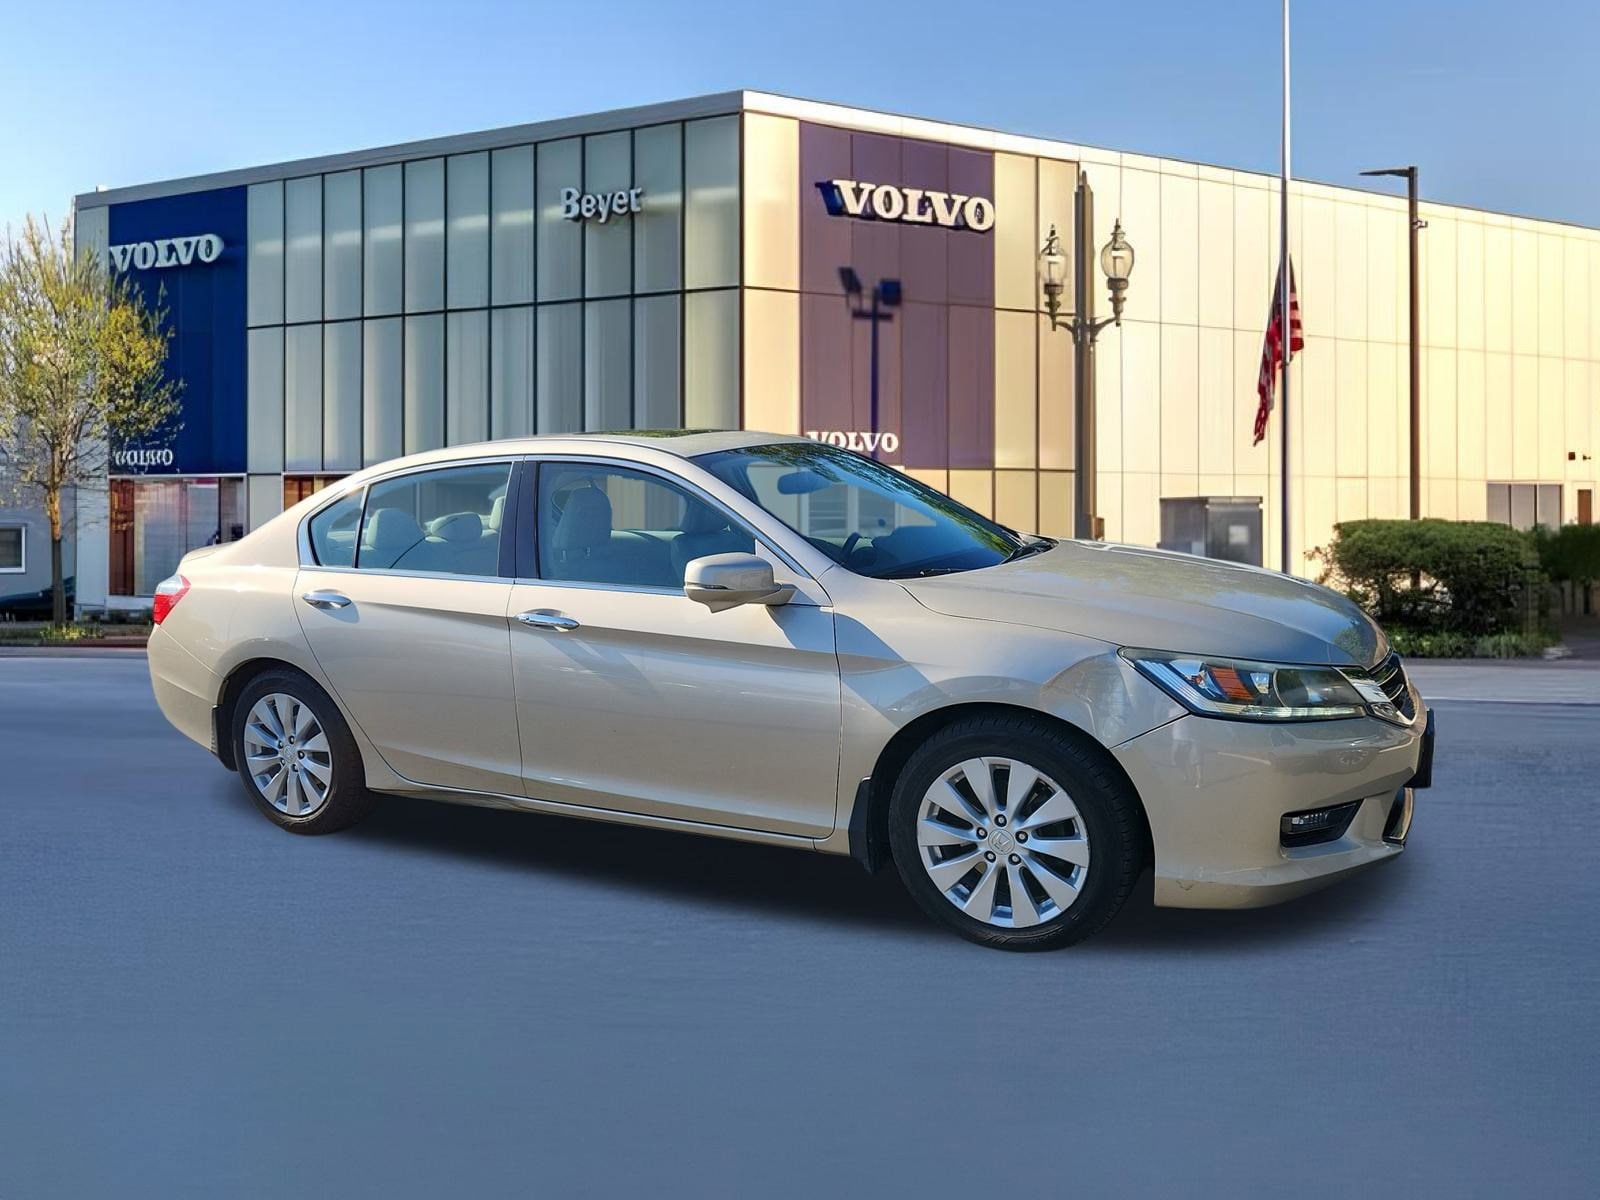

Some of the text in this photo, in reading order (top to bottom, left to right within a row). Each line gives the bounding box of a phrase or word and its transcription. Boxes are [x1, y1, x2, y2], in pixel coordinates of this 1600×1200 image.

[560, 187, 642, 223] Beyer
[832, 179, 996, 231] VOLVO
[109, 233, 224, 272] VOLVO
